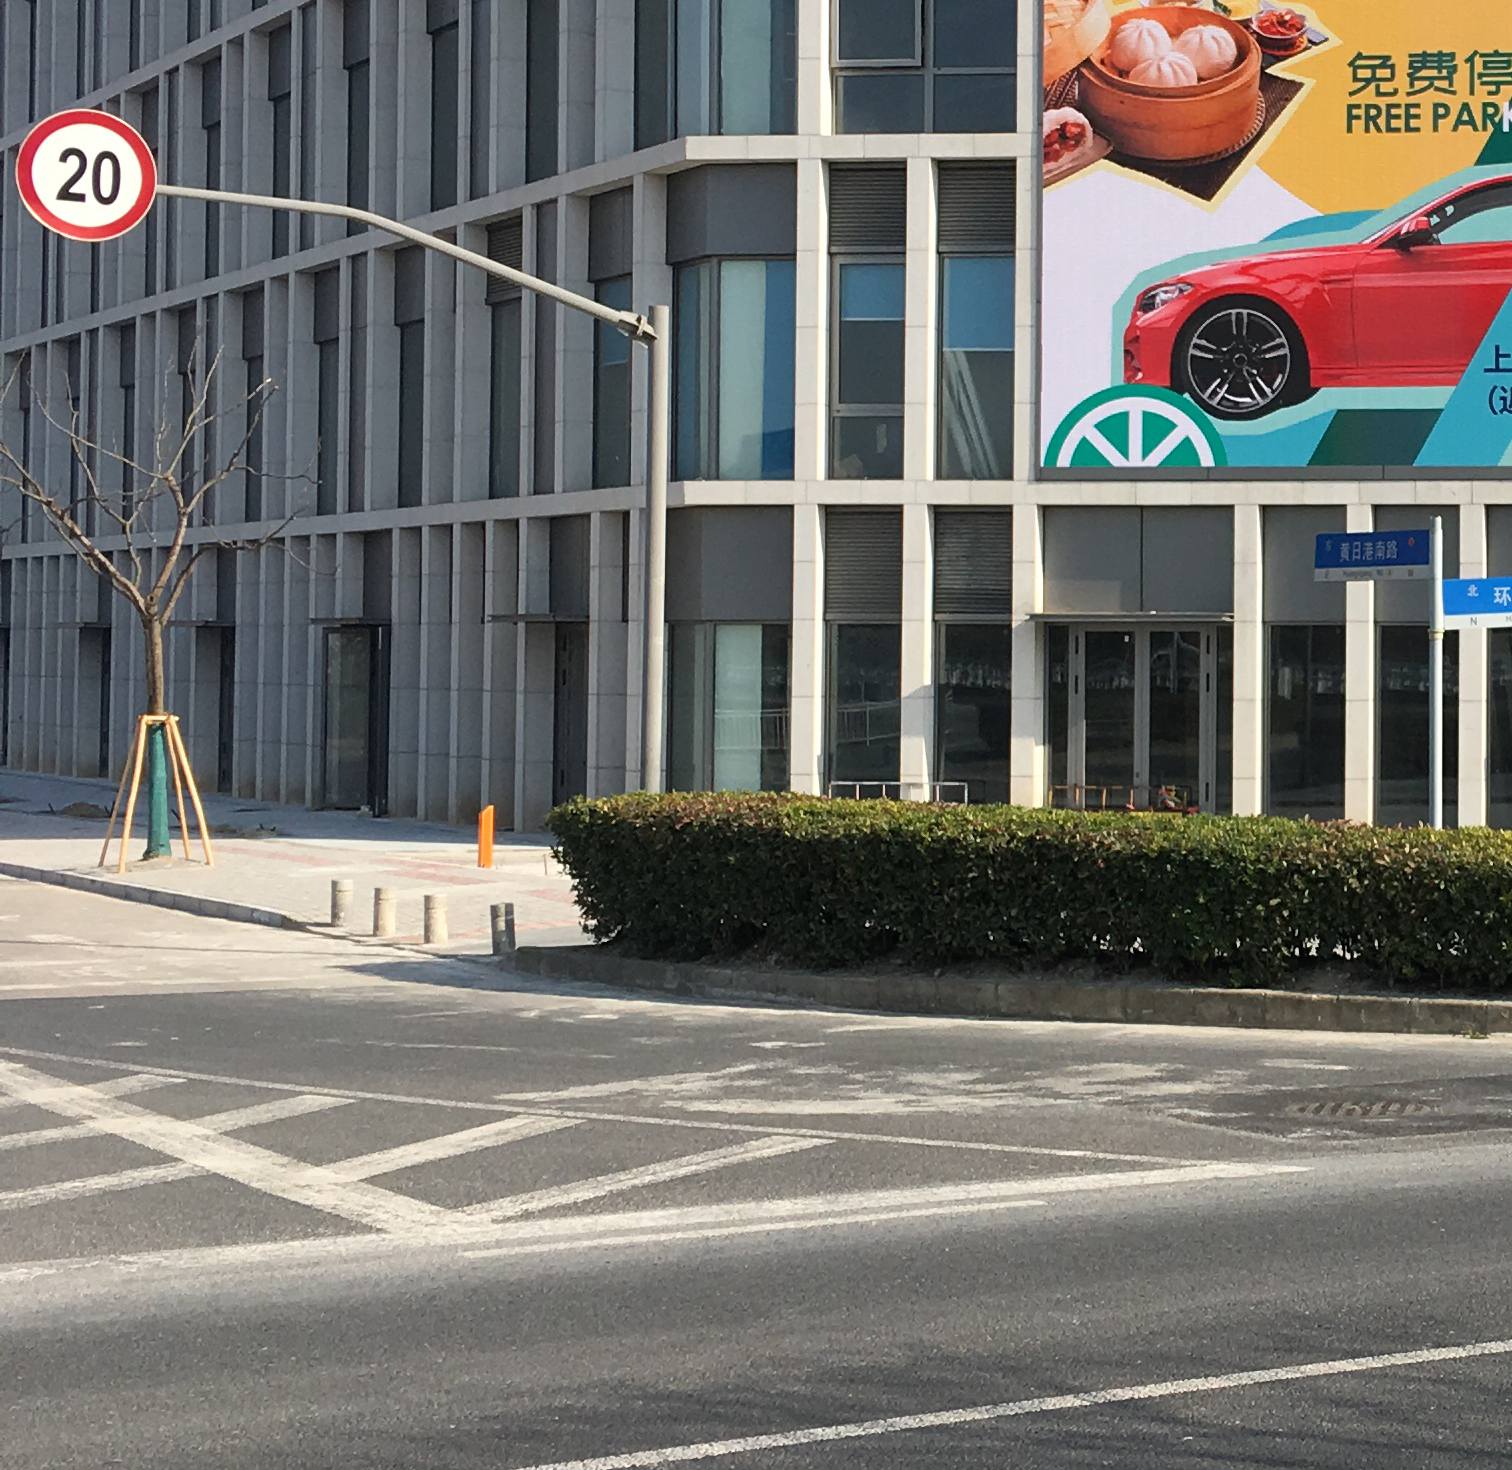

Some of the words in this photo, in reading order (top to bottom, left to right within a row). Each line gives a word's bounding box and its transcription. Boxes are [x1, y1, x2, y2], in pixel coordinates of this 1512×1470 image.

[1345, 102, 1421, 134] FREE
[56, 147, 121, 205] 20
[1467, 584, 1479, 597] 北
[1470, 617, 1478, 626] N
